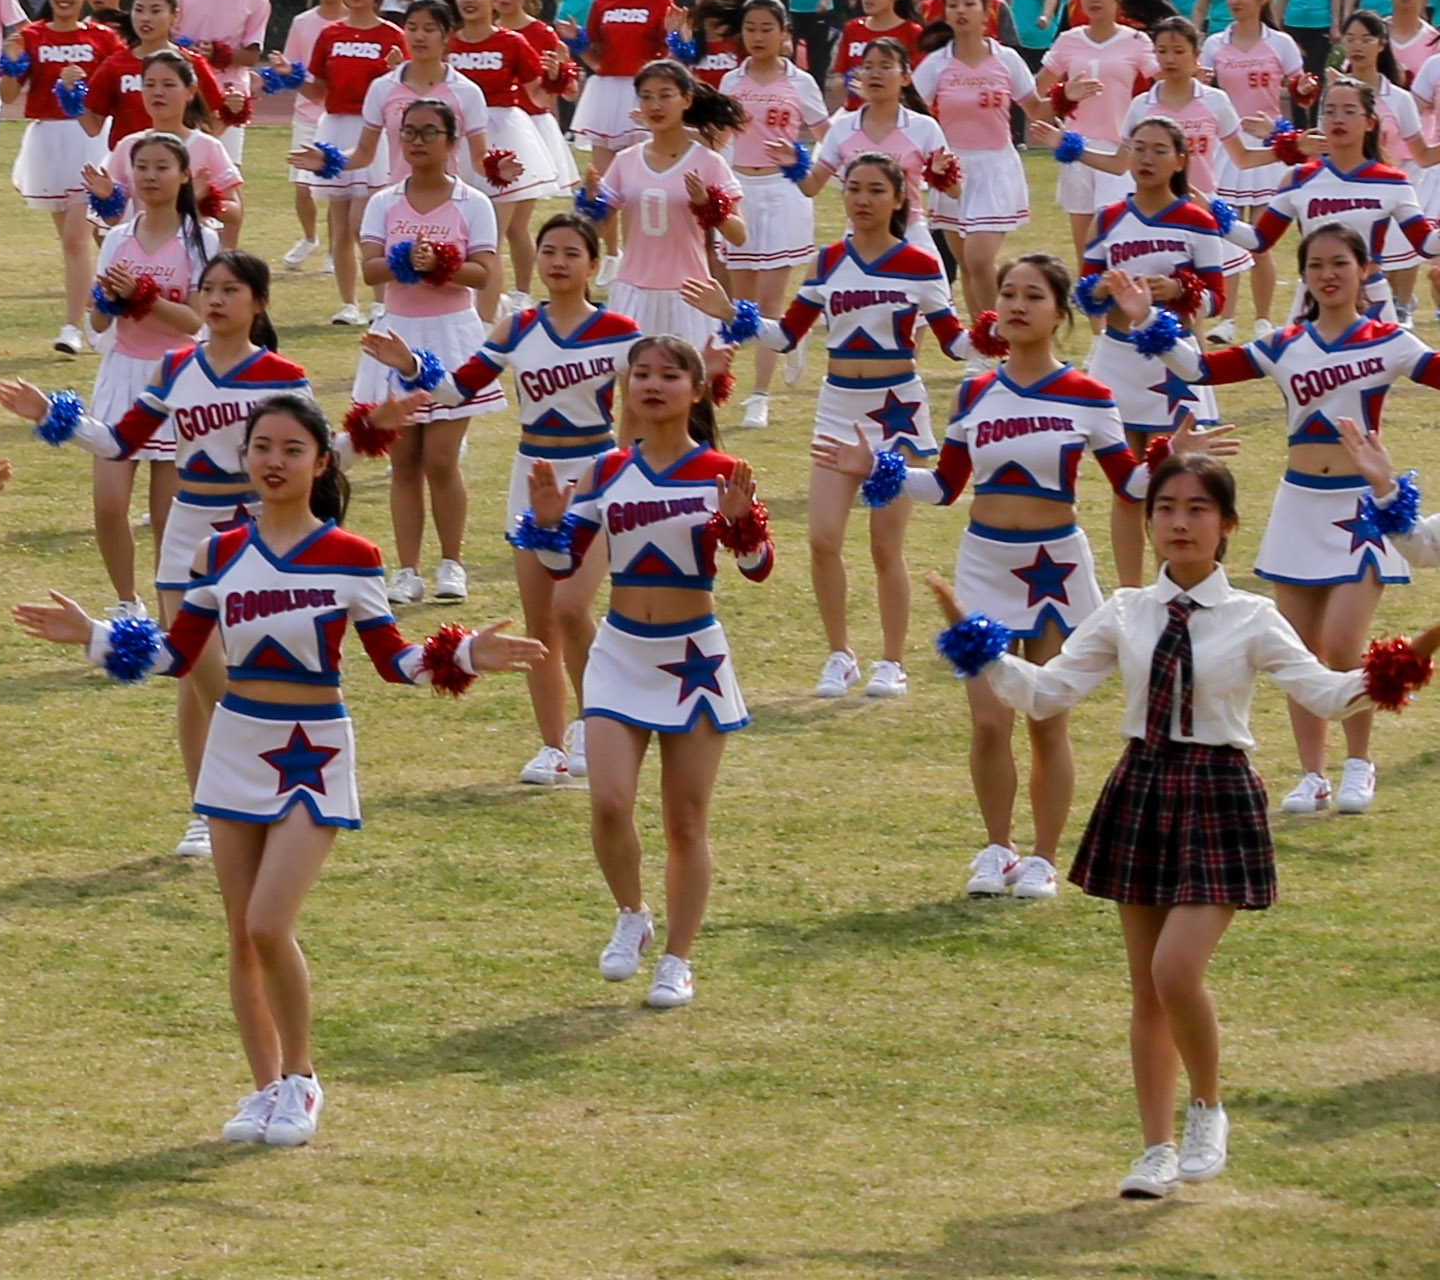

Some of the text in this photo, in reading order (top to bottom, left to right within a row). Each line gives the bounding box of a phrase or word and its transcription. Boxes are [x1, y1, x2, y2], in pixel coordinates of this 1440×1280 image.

[603, 7, 650, 24] PARIS
[39, 42, 93, 63] PARIS
[332, 41, 381, 59] PARIS
[449, 52, 503, 70] PARIS
[390, 220, 451, 240] Happy
[641, 188, 668, 237] 0
[521, 356, 616, 403] GOODLUCK
[1291, 358, 1385, 406] GOODLUCK
[175, 401, 256, 442] GOODL
[607, 497, 706, 536] GOODLUCK
[225, 588, 336, 628] GOODLUCK
